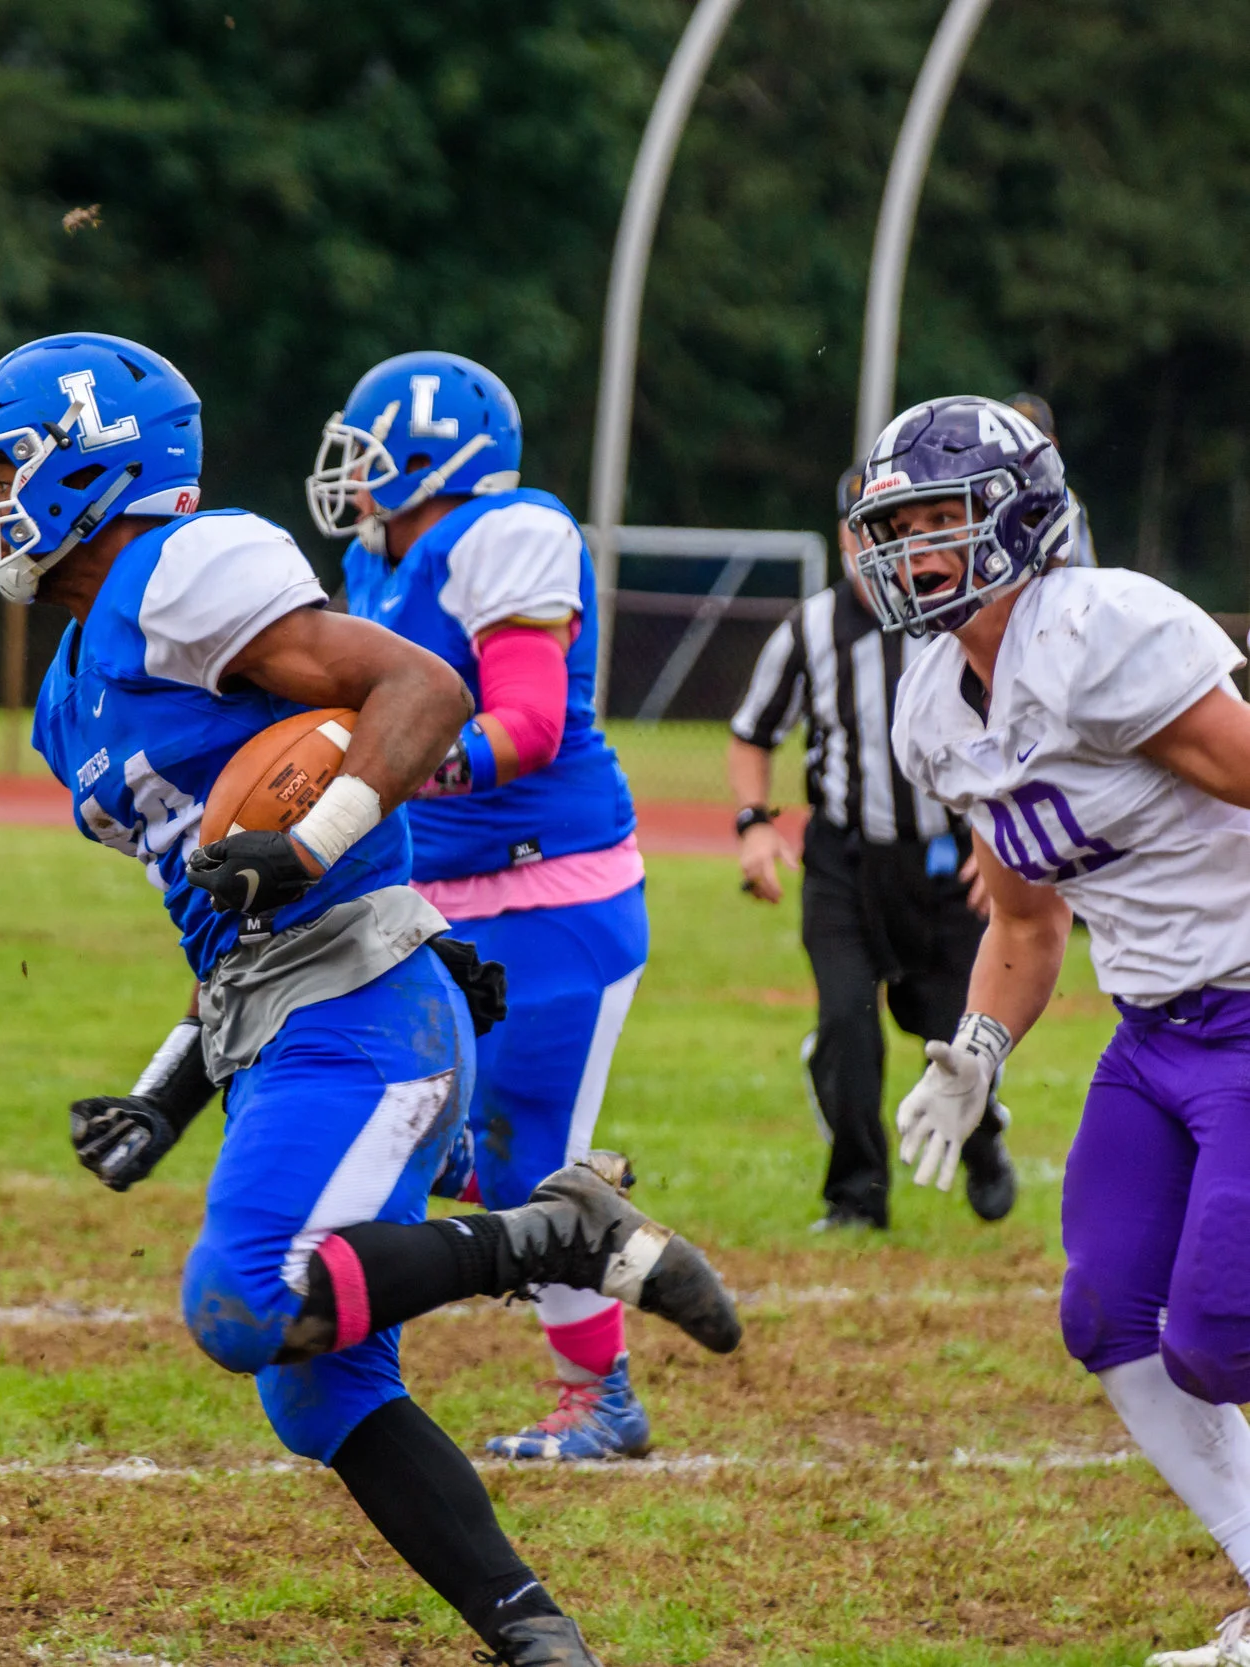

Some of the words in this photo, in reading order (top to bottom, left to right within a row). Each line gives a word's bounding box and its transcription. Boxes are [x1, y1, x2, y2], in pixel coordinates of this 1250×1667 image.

[57, 369, 141, 454] L
[410, 374, 459, 440] L
[246, 917, 261, 931] M
